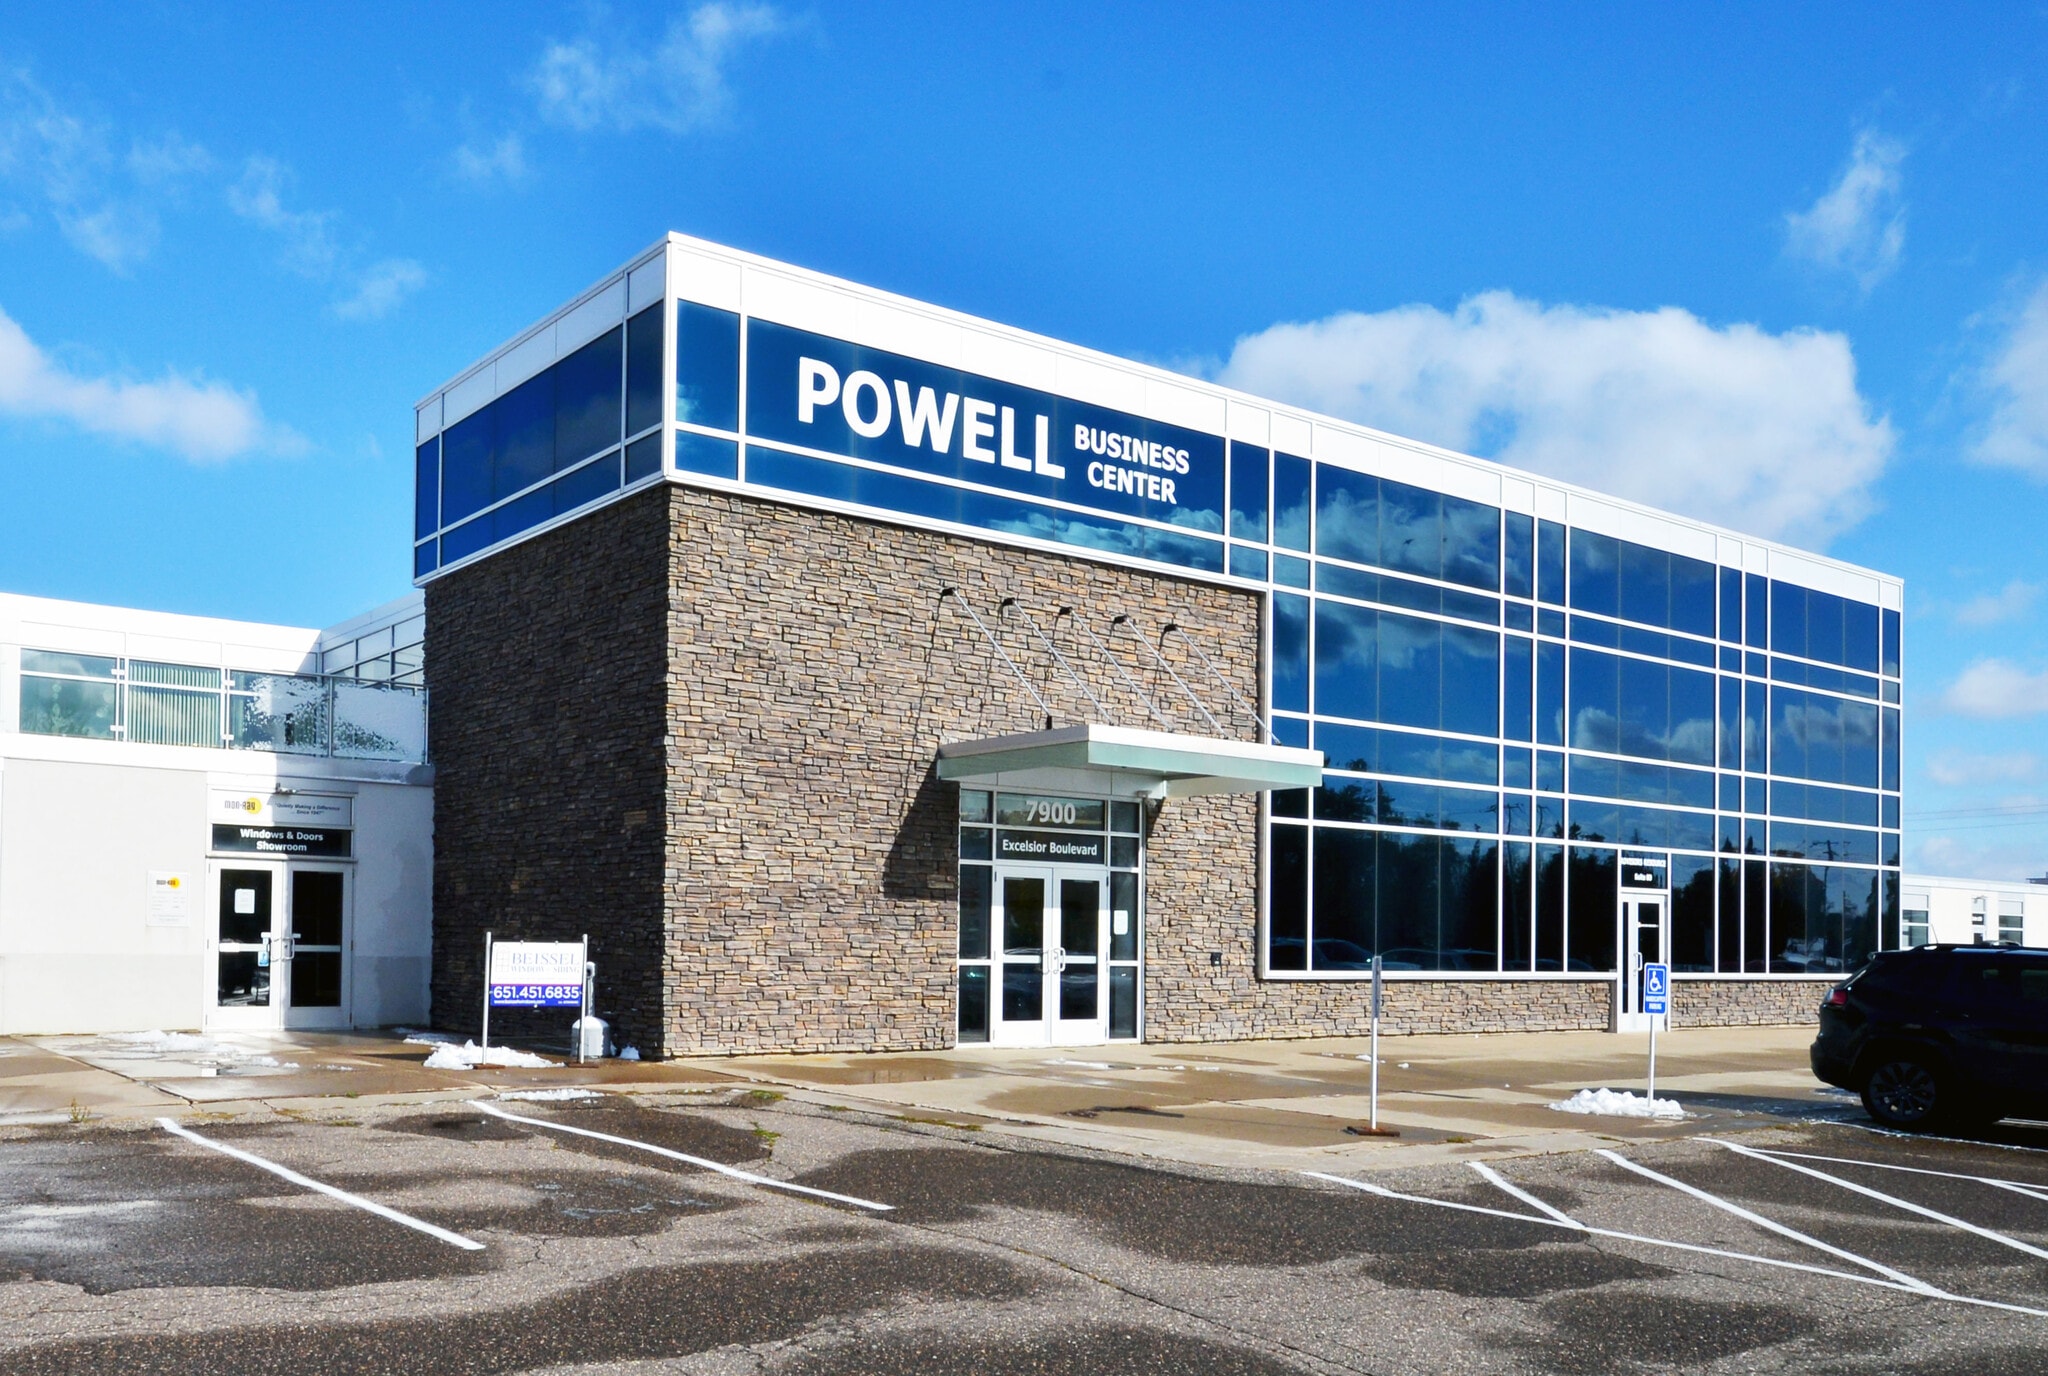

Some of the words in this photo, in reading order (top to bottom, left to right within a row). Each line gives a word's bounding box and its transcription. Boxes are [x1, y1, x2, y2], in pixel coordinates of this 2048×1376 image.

[798, 356, 1066, 480] POWELL
[1074, 424, 1190, 474] BUSINESS
[1087, 461, 1178, 504] CENTER
[1025, 800, 1076, 825] 7900
[240, 828, 284, 839] Windows
[286, 831, 294, 840] &
[296, 831, 324, 841] Doors
[256, 841, 307, 851] Showroom
[1002, 839, 1047, 853] Excelsior
[1050, 842, 1097, 856] Boulevard
[493, 986, 580, 999] 651.451.6835
